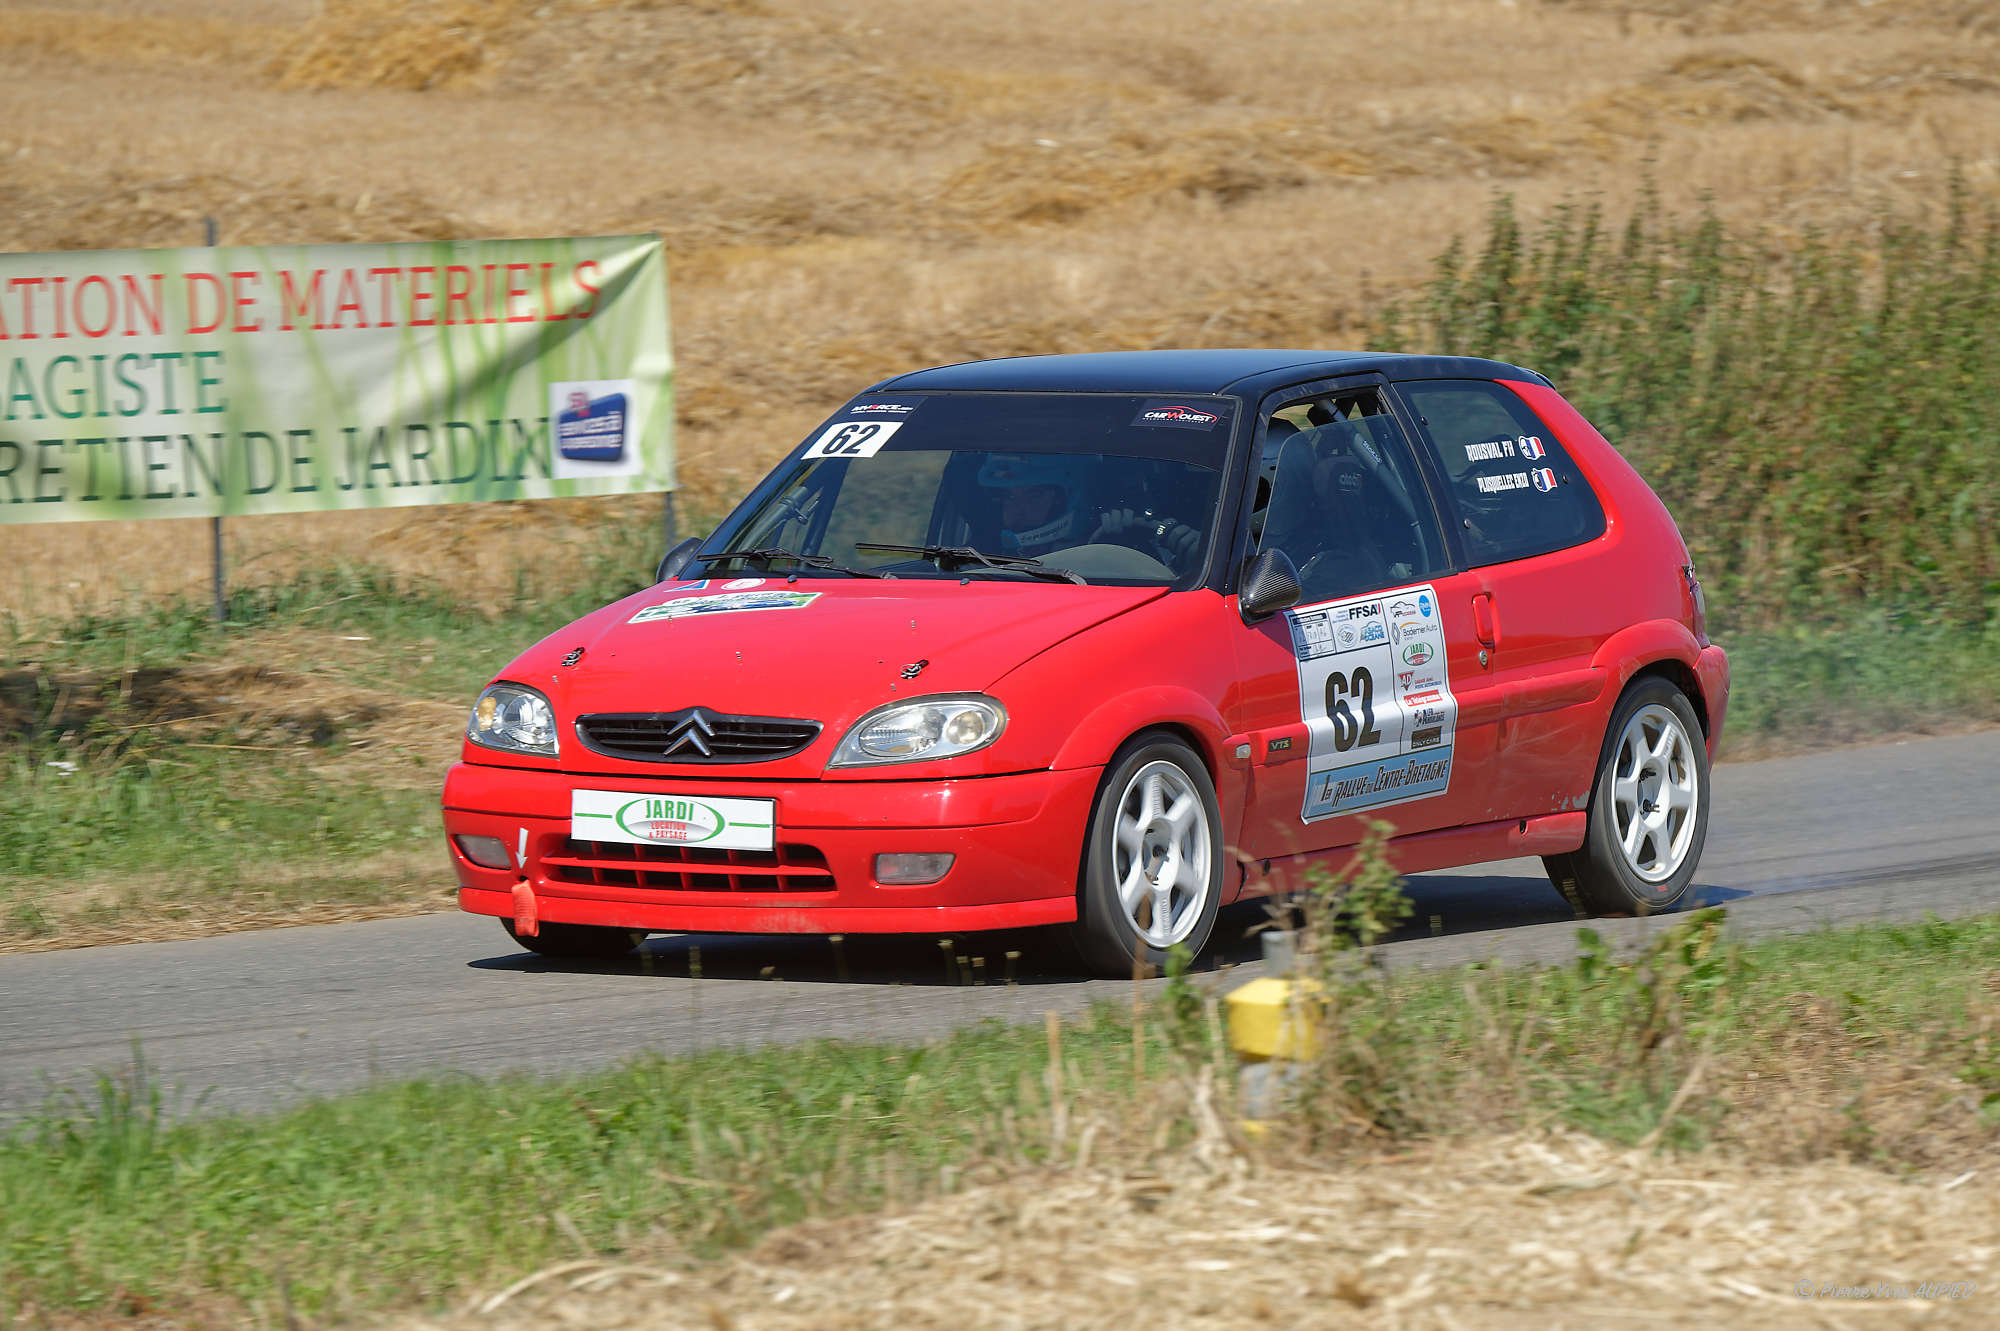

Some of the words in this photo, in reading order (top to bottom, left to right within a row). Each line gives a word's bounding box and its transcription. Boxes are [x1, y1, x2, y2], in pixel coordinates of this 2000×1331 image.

[0, 273, 167, 340] TION
[182, 270, 264, 335] DE
[277, 260, 603, 331] MATERIELS
[4, 351, 231, 420] AGISTE
[241, 429, 319, 495] DE
[337, 416, 550, 491] JARDIN
[822, 424, 881, 455] 62
[1349, 604, 1378, 620] FFSA
[1325, 666, 1382, 752] 62
[1271, 740, 1290, 750] VTS
[1332, 776, 1369, 808] RALLYE
[645, 799, 694, 821] JARDI
